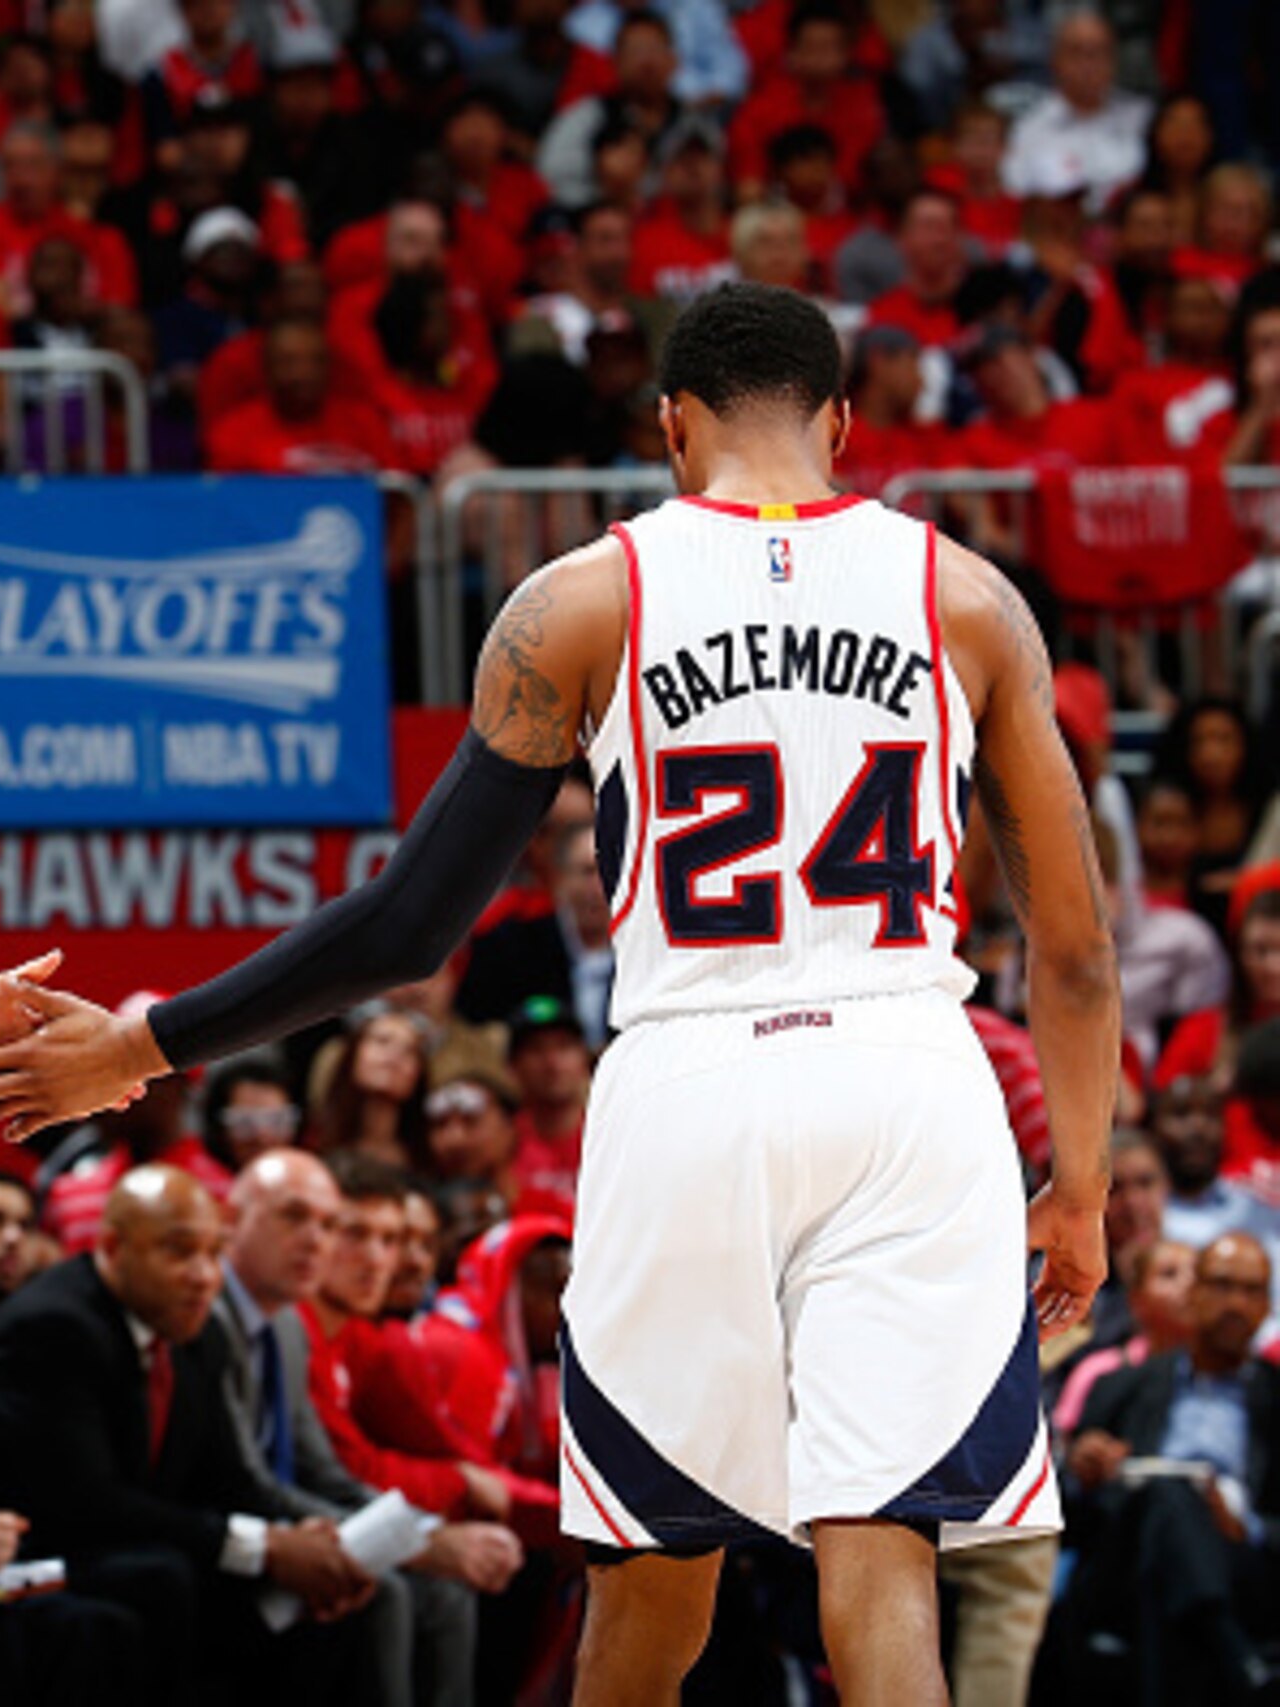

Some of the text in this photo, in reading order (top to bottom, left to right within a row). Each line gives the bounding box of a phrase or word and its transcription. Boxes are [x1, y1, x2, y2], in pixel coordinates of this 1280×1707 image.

[642, 624, 934, 730] BAZEMORE
[162, 722, 270, 787] NBA
[271, 721, 340, 787] TV
[654, 740, 936, 949] 24
